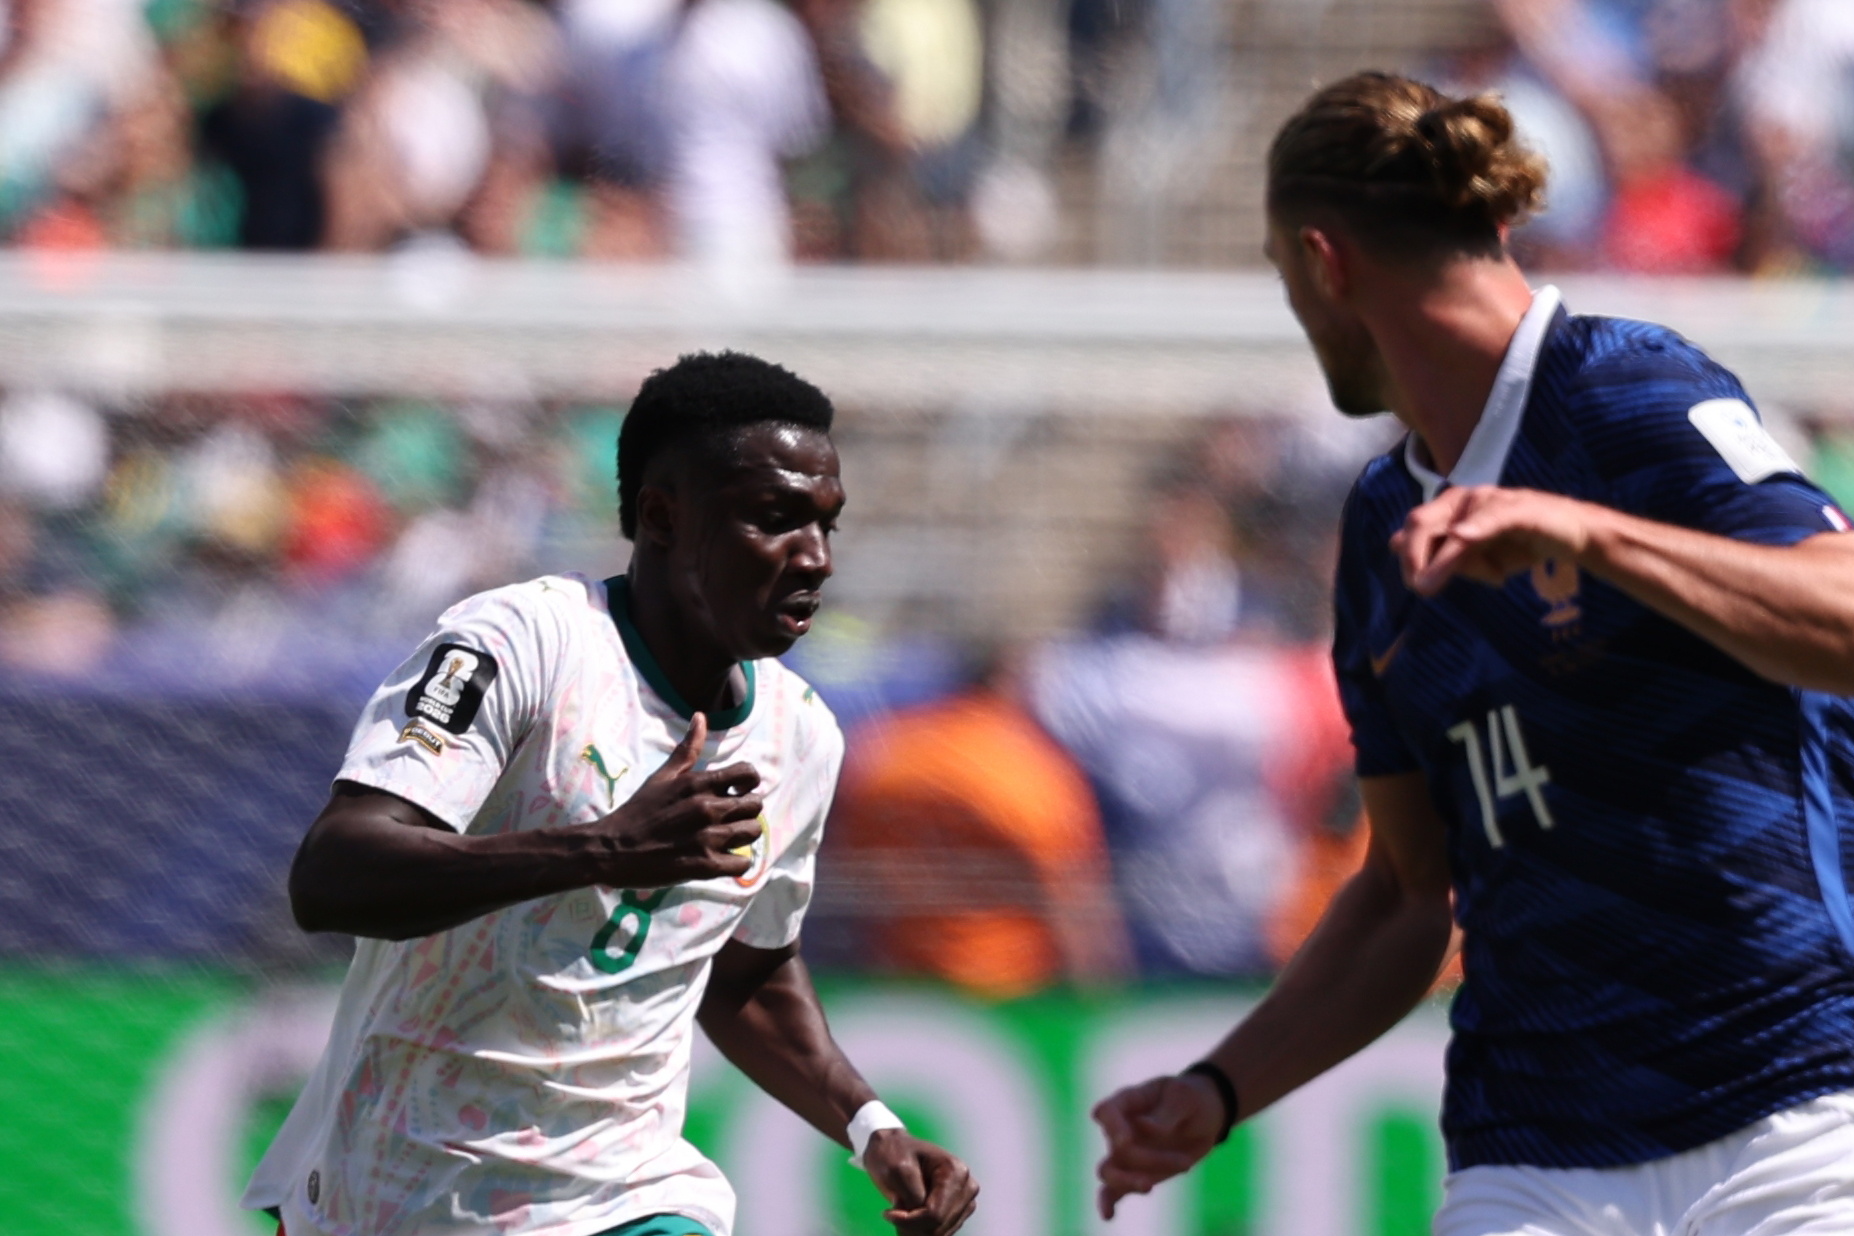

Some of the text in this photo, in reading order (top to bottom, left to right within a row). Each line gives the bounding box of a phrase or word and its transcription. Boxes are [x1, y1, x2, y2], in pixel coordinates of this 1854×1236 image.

[414, 700, 451, 725] 2026
[1448, 704, 1555, 850] 14
[590, 887, 673, 974] 8
